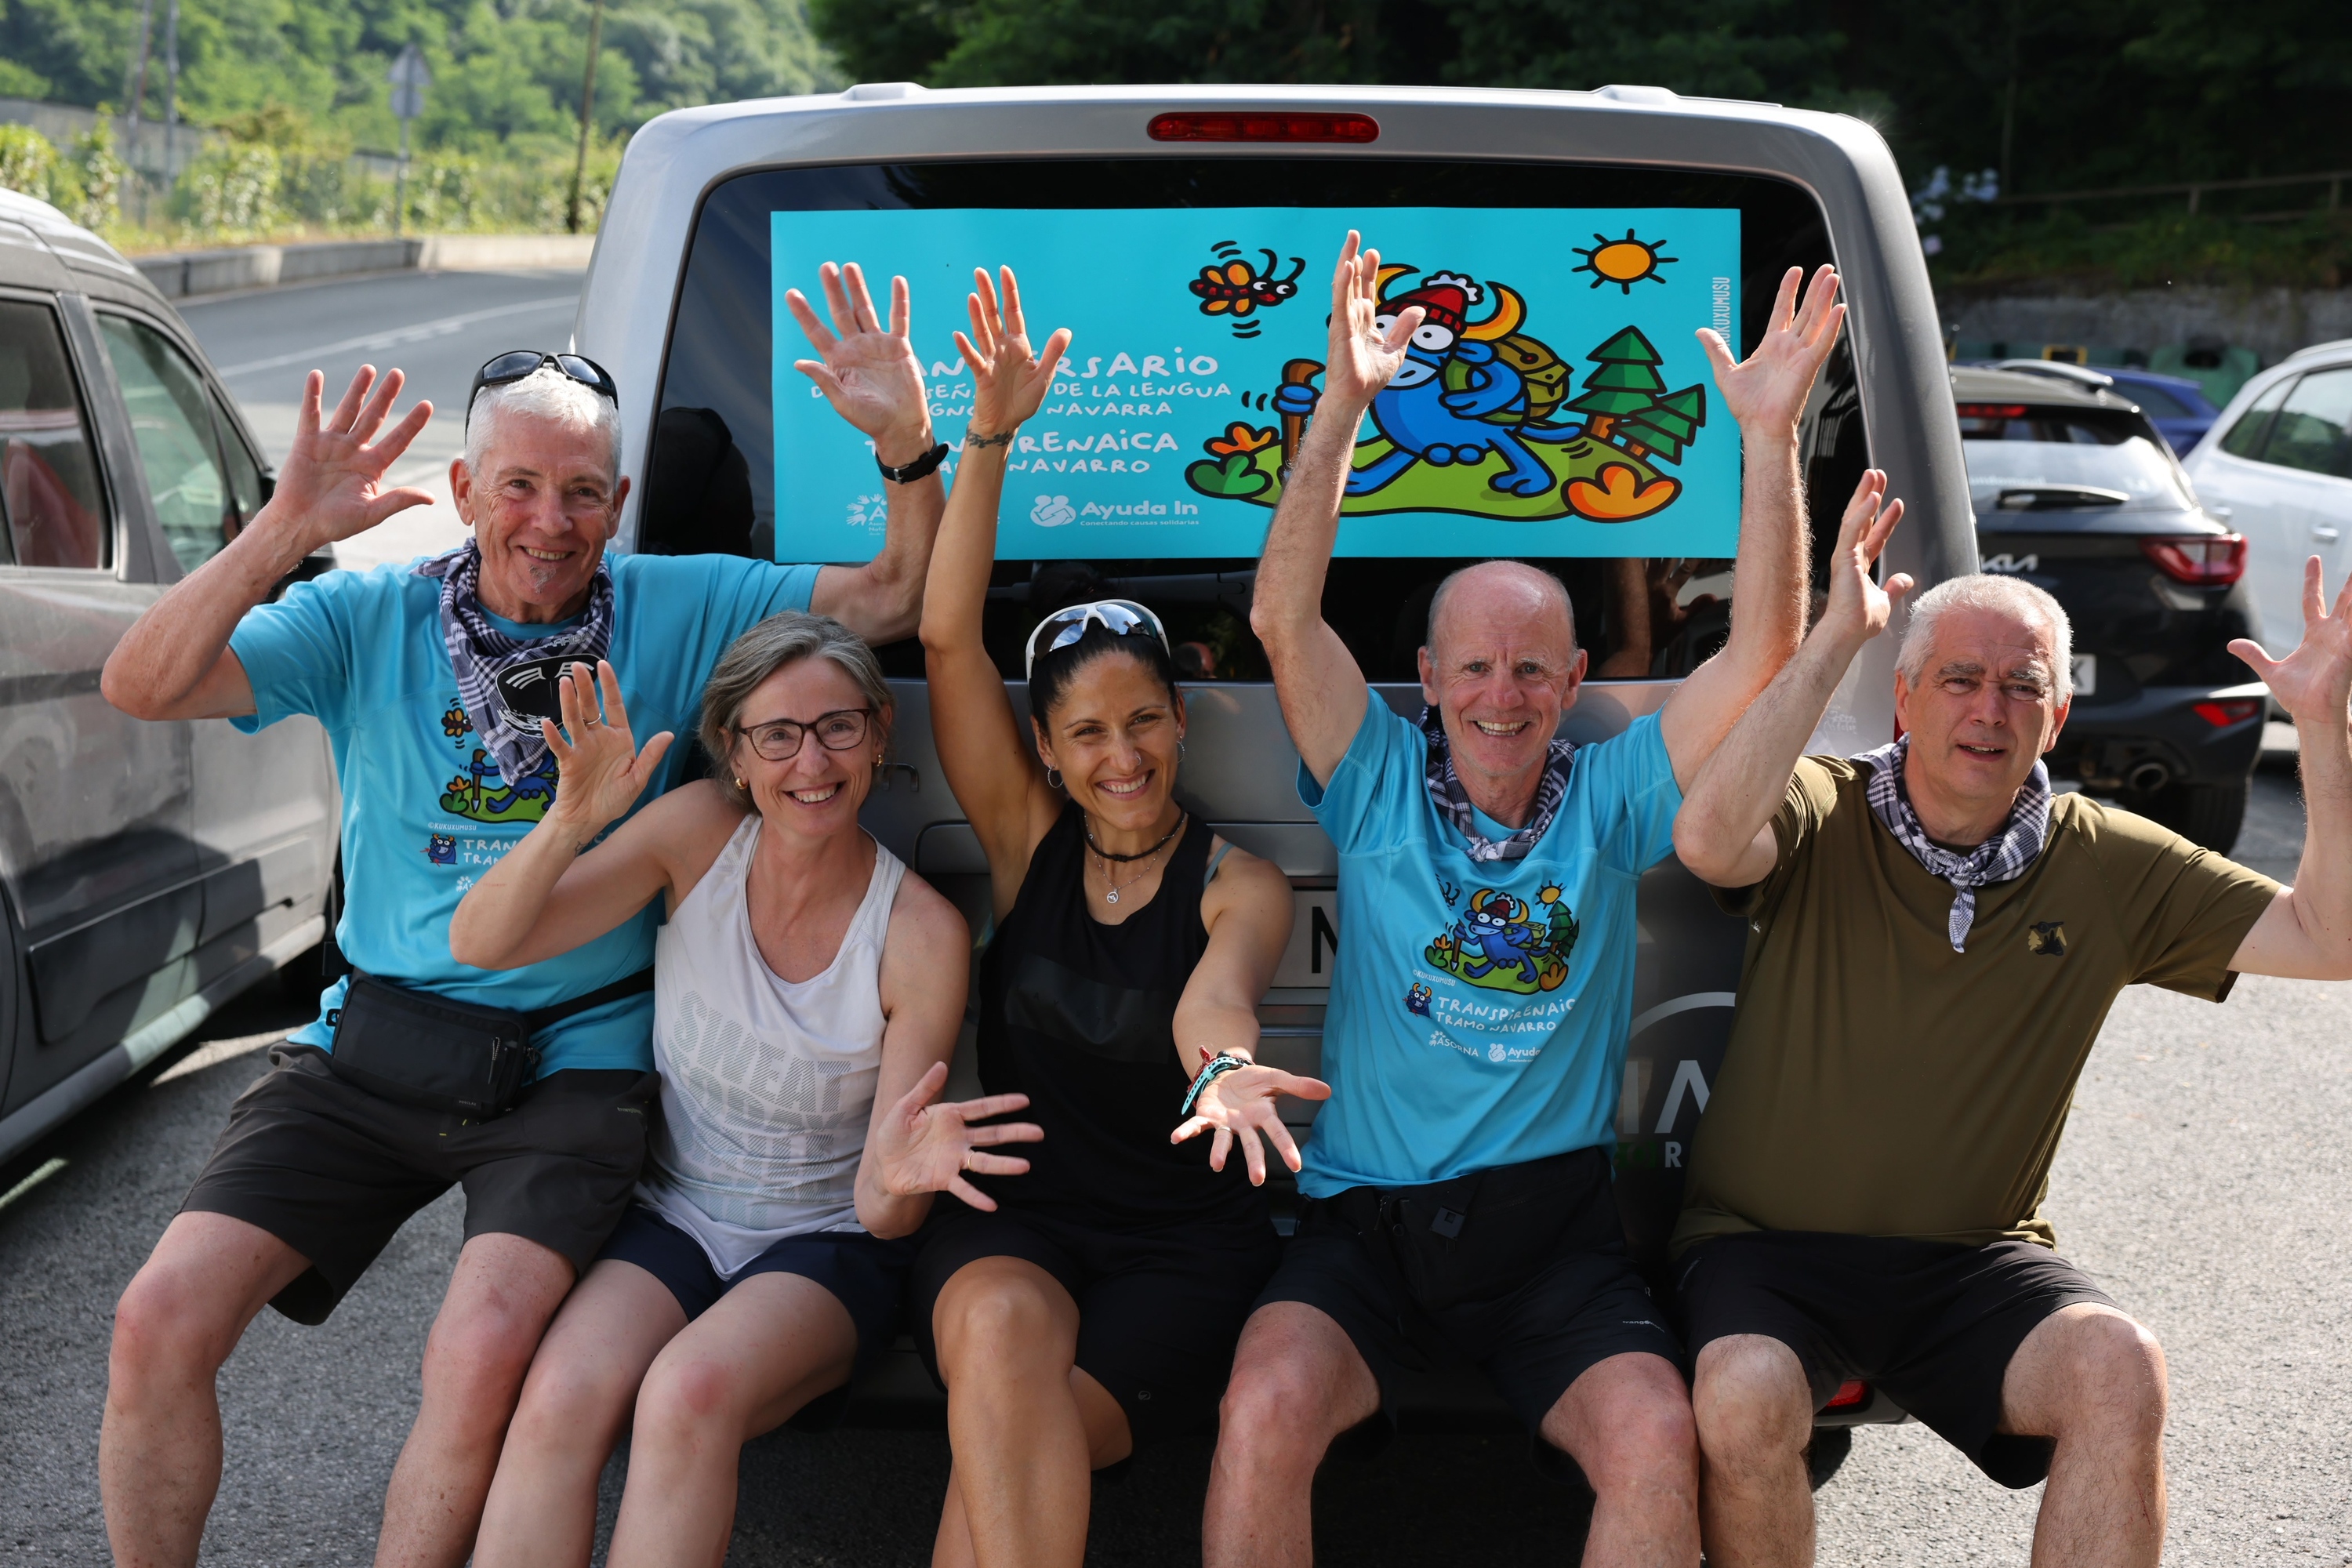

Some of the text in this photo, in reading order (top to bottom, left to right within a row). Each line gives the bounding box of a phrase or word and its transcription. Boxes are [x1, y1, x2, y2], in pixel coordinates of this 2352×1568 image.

[1054, 383, 1083, 397] DE
[1091, 384, 1121, 397] LA
[1130, 382, 1232, 398] LENGUA
[1047, 401, 1173, 416] NAVARRA
[1009, 459, 1151, 474] NAVARRO
[1080, 500, 1199, 520] Ayuda In
[1436, 1011, 1556, 1033] TRAMO NAVARRO
[1437, 1037, 1479, 1057] ASORNA
